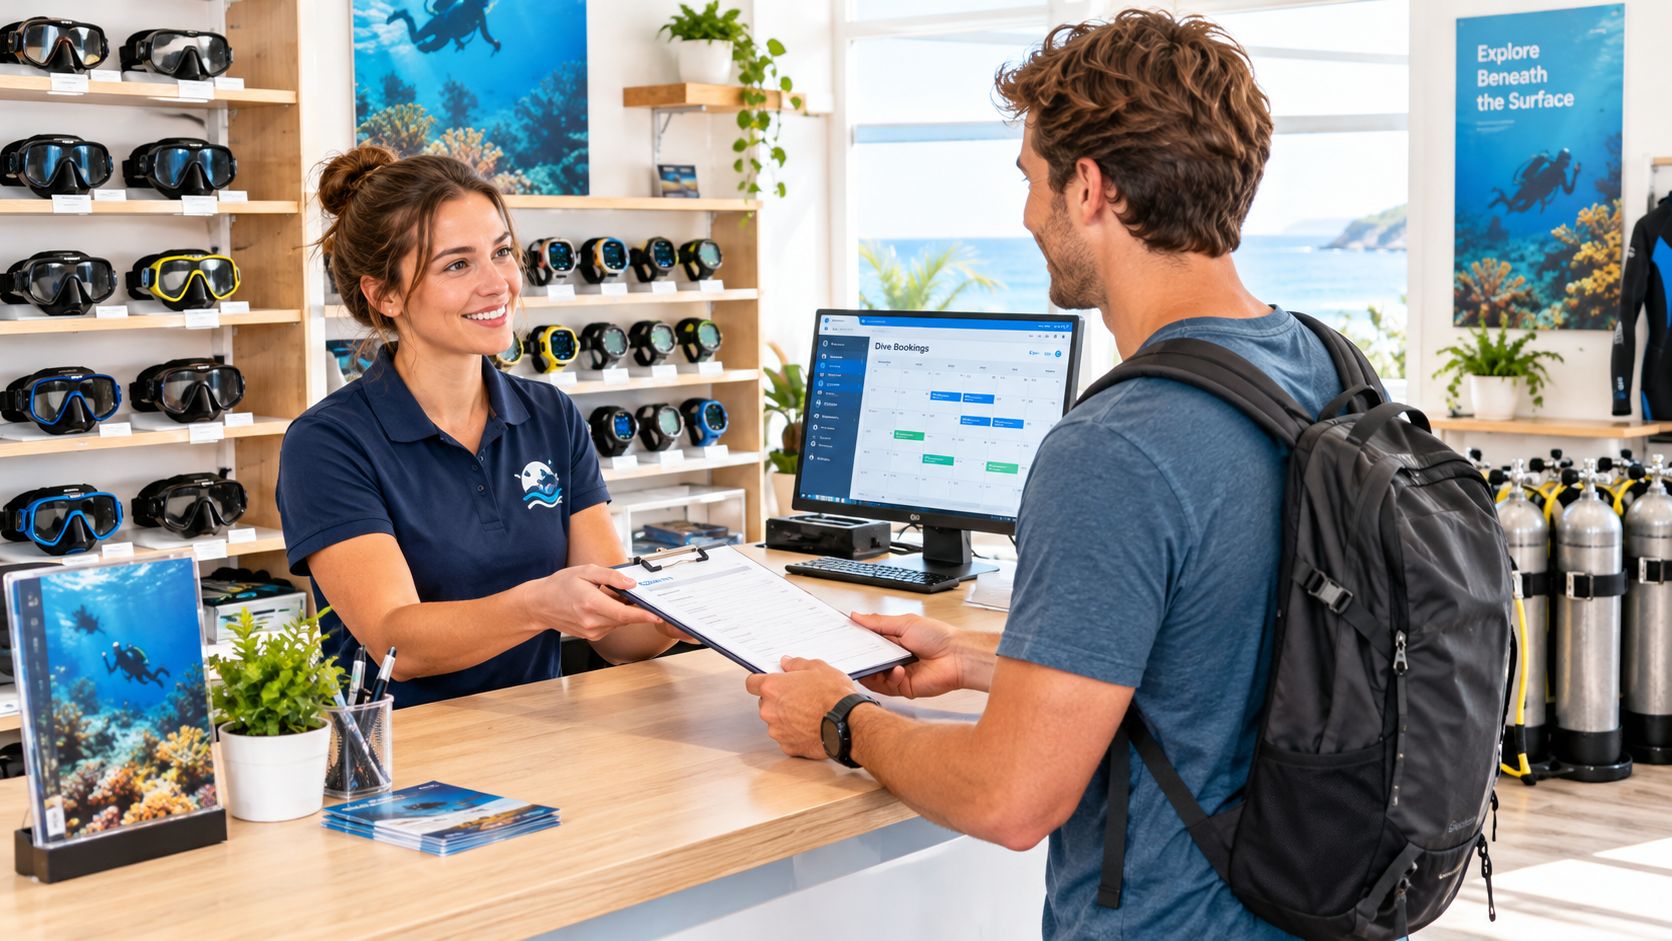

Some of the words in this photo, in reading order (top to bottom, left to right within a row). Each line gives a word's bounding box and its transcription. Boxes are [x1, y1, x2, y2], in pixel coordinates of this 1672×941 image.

[1477, 42, 1540, 65] Explore
[1477, 66, 1548, 87] Beneath
[1476, 92, 1505, 112] the
[1508, 90, 1575, 110] Surface
[874, 342, 892, 352] Dive
[893, 342, 930, 354] Bookings
